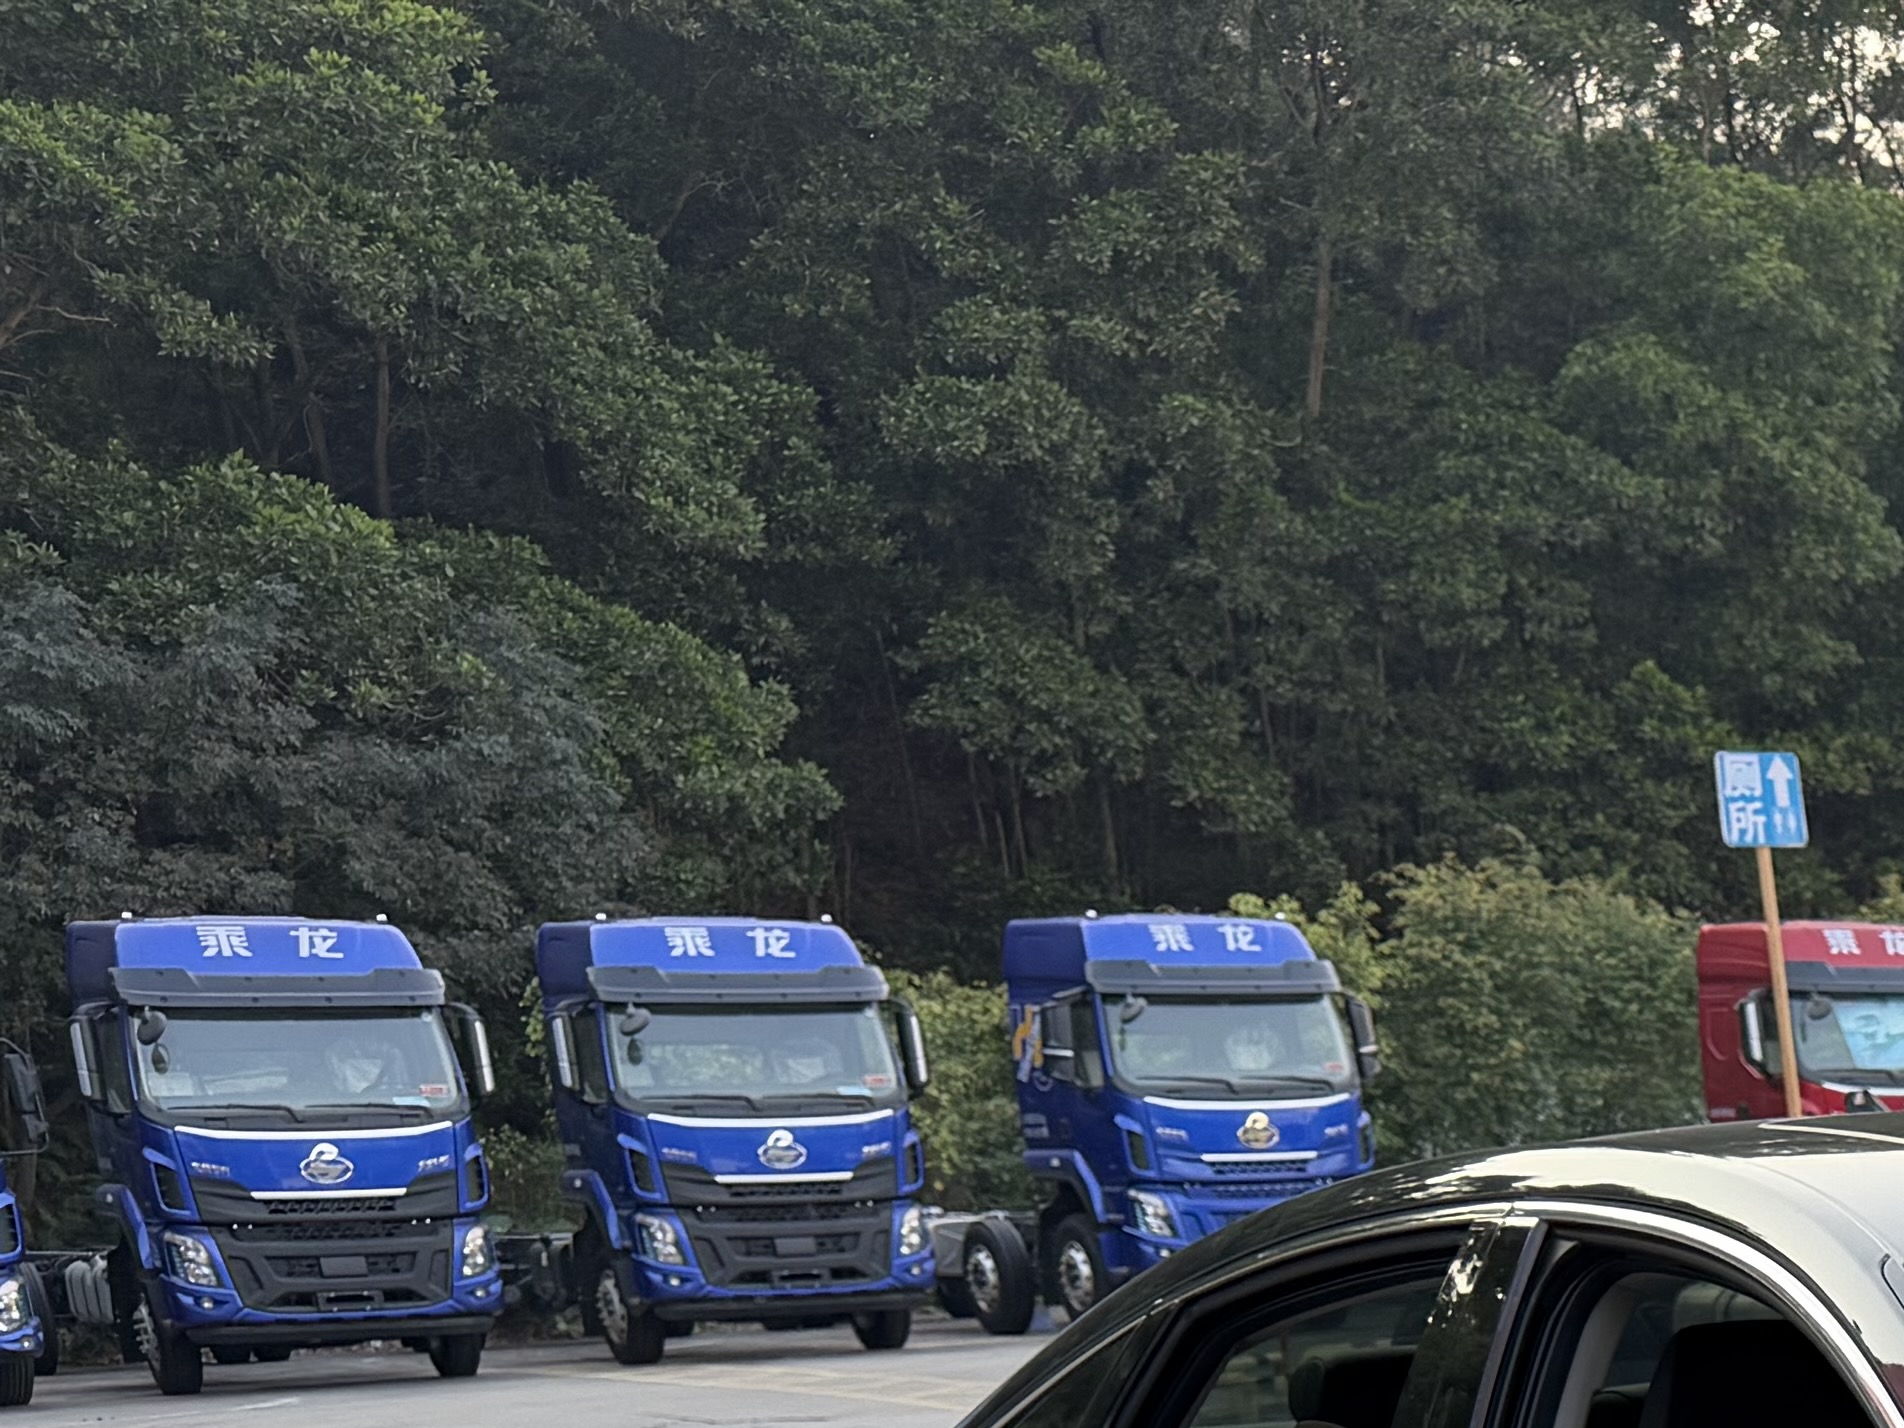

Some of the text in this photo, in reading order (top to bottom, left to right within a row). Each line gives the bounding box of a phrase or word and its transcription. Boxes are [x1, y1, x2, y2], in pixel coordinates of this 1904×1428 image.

[1723, 755, 1768, 844] 厕所
[196, 926, 344, 958] 乘龙
[664, 927, 796, 958] 乘龙
[1148, 924, 1263, 952] 乘龙
